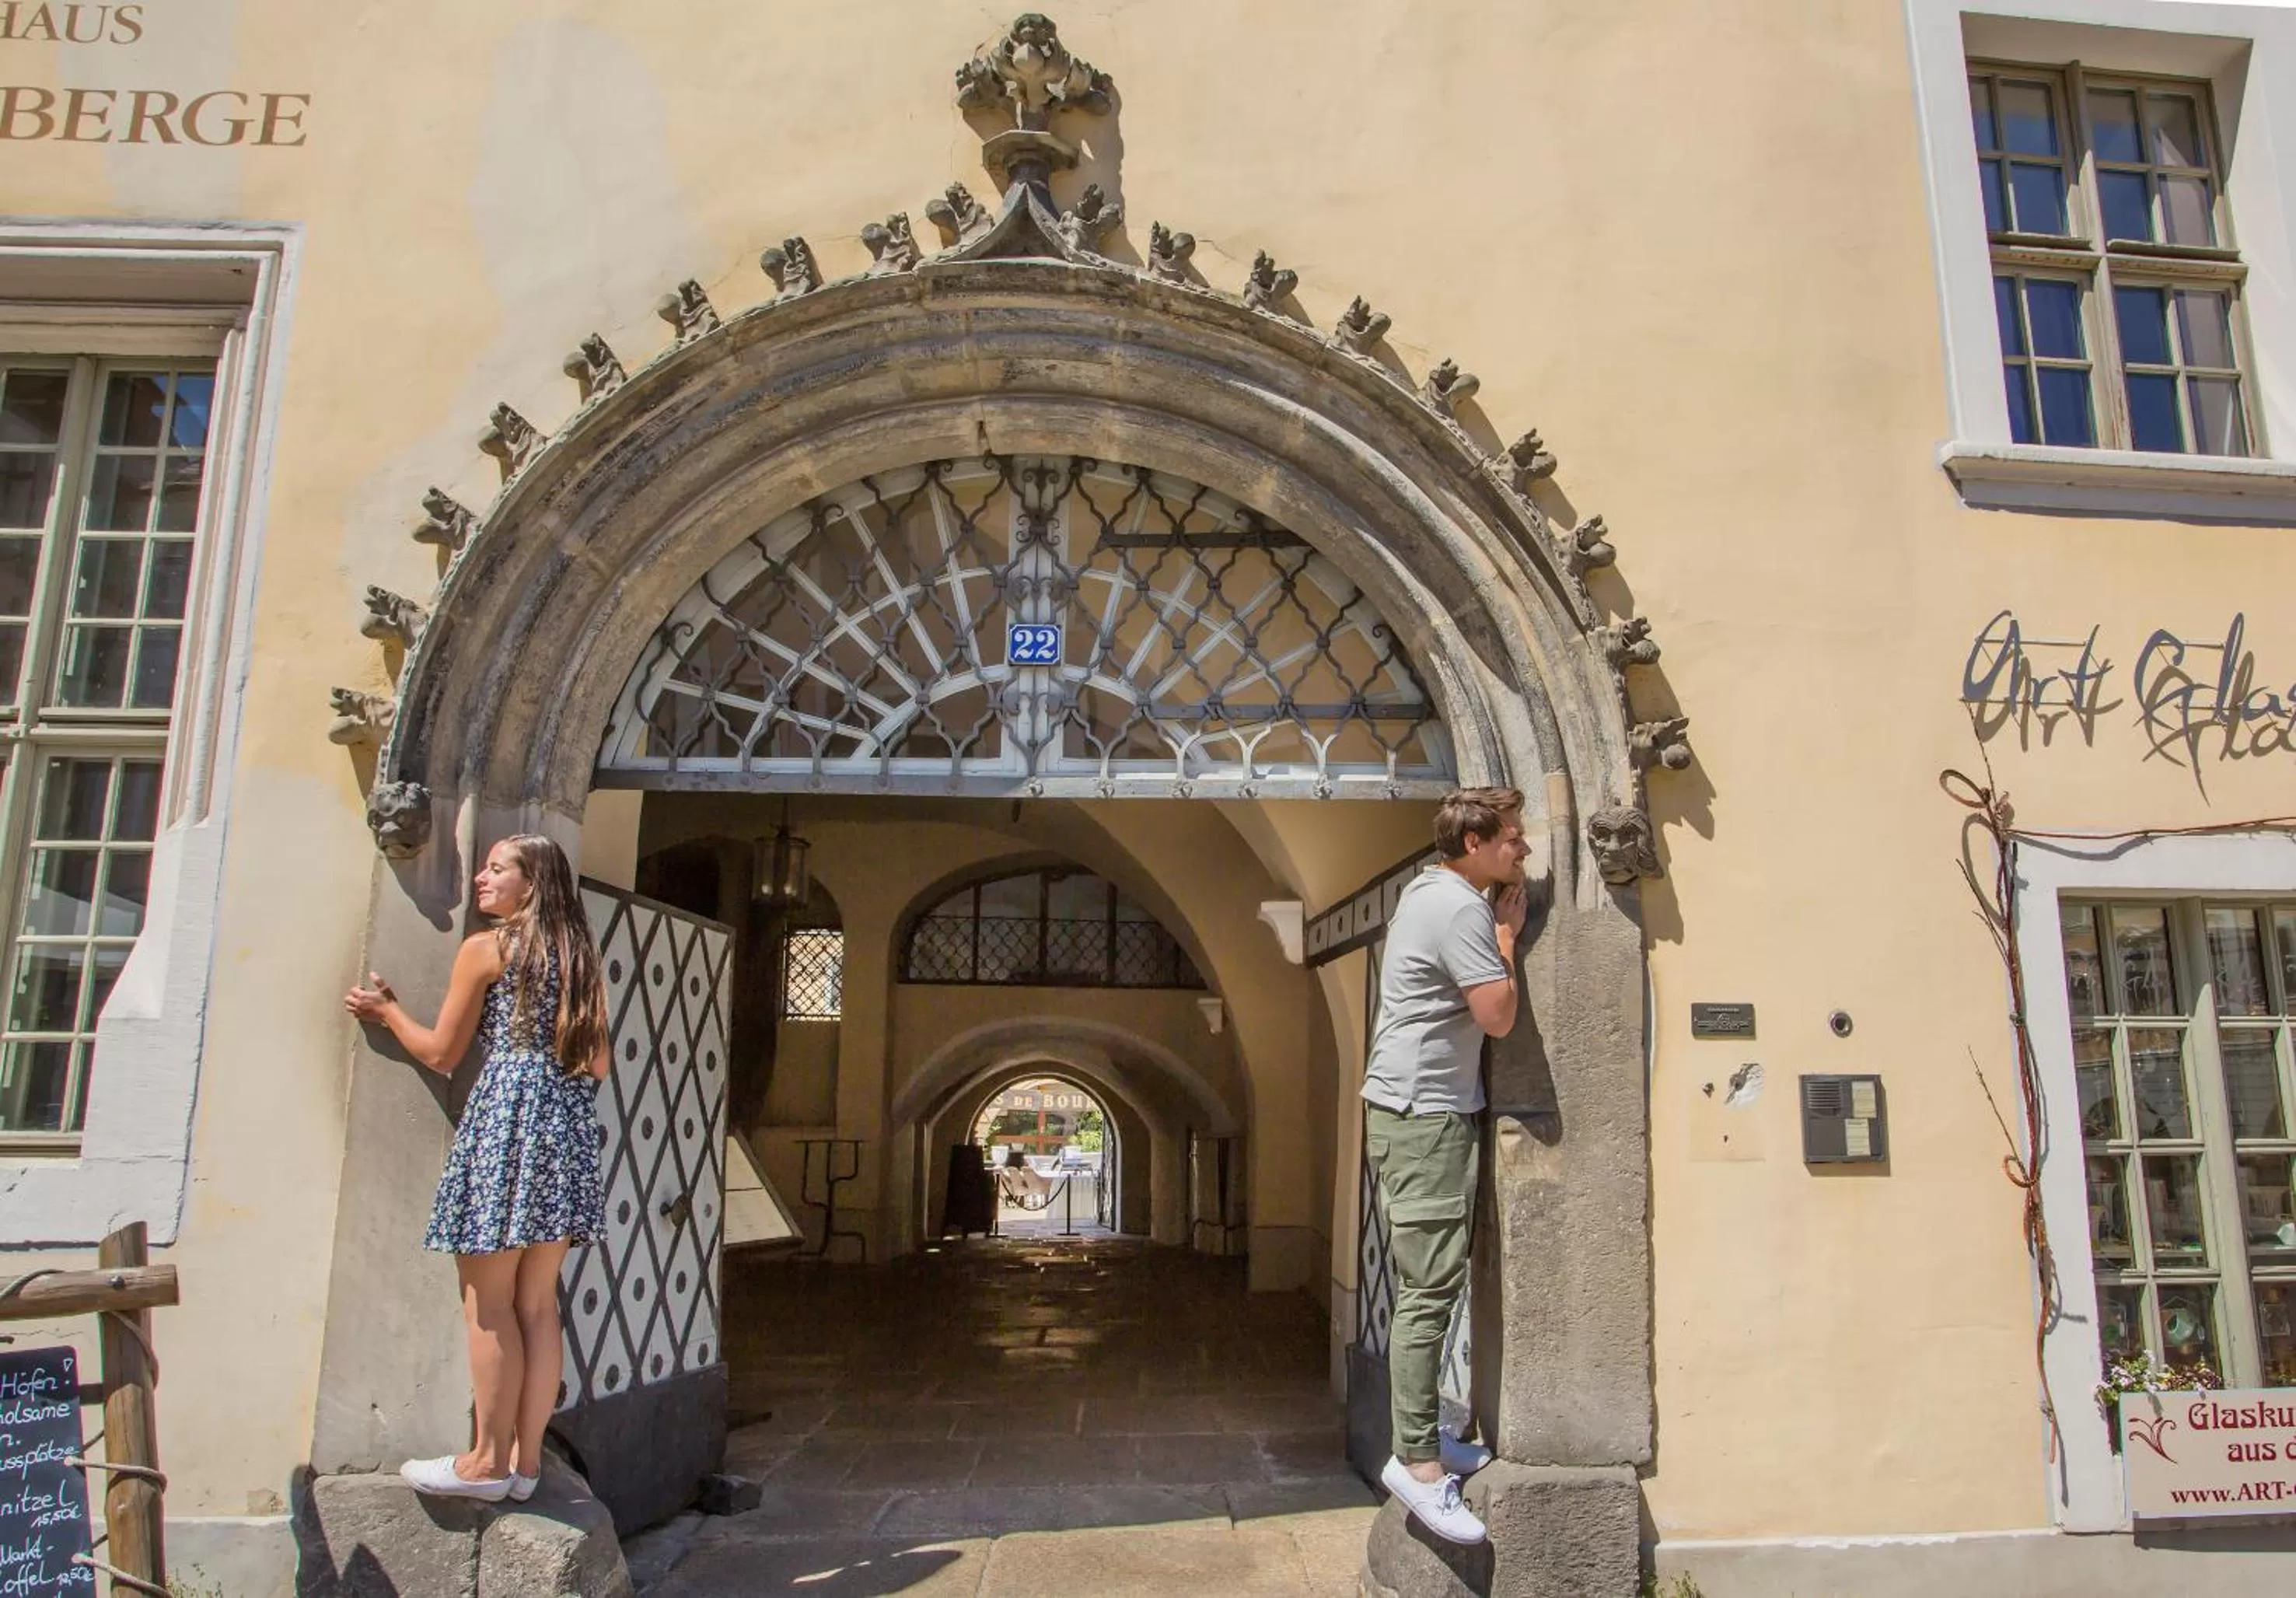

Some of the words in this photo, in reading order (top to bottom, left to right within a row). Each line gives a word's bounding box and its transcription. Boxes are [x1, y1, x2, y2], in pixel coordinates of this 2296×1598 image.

[0, 86, 310, 146] BERGE
[1014, 630, 1055, 659] 22
[1962, 610, 2114, 714] Art
[2228, 1442, 2277, 1462] aus
